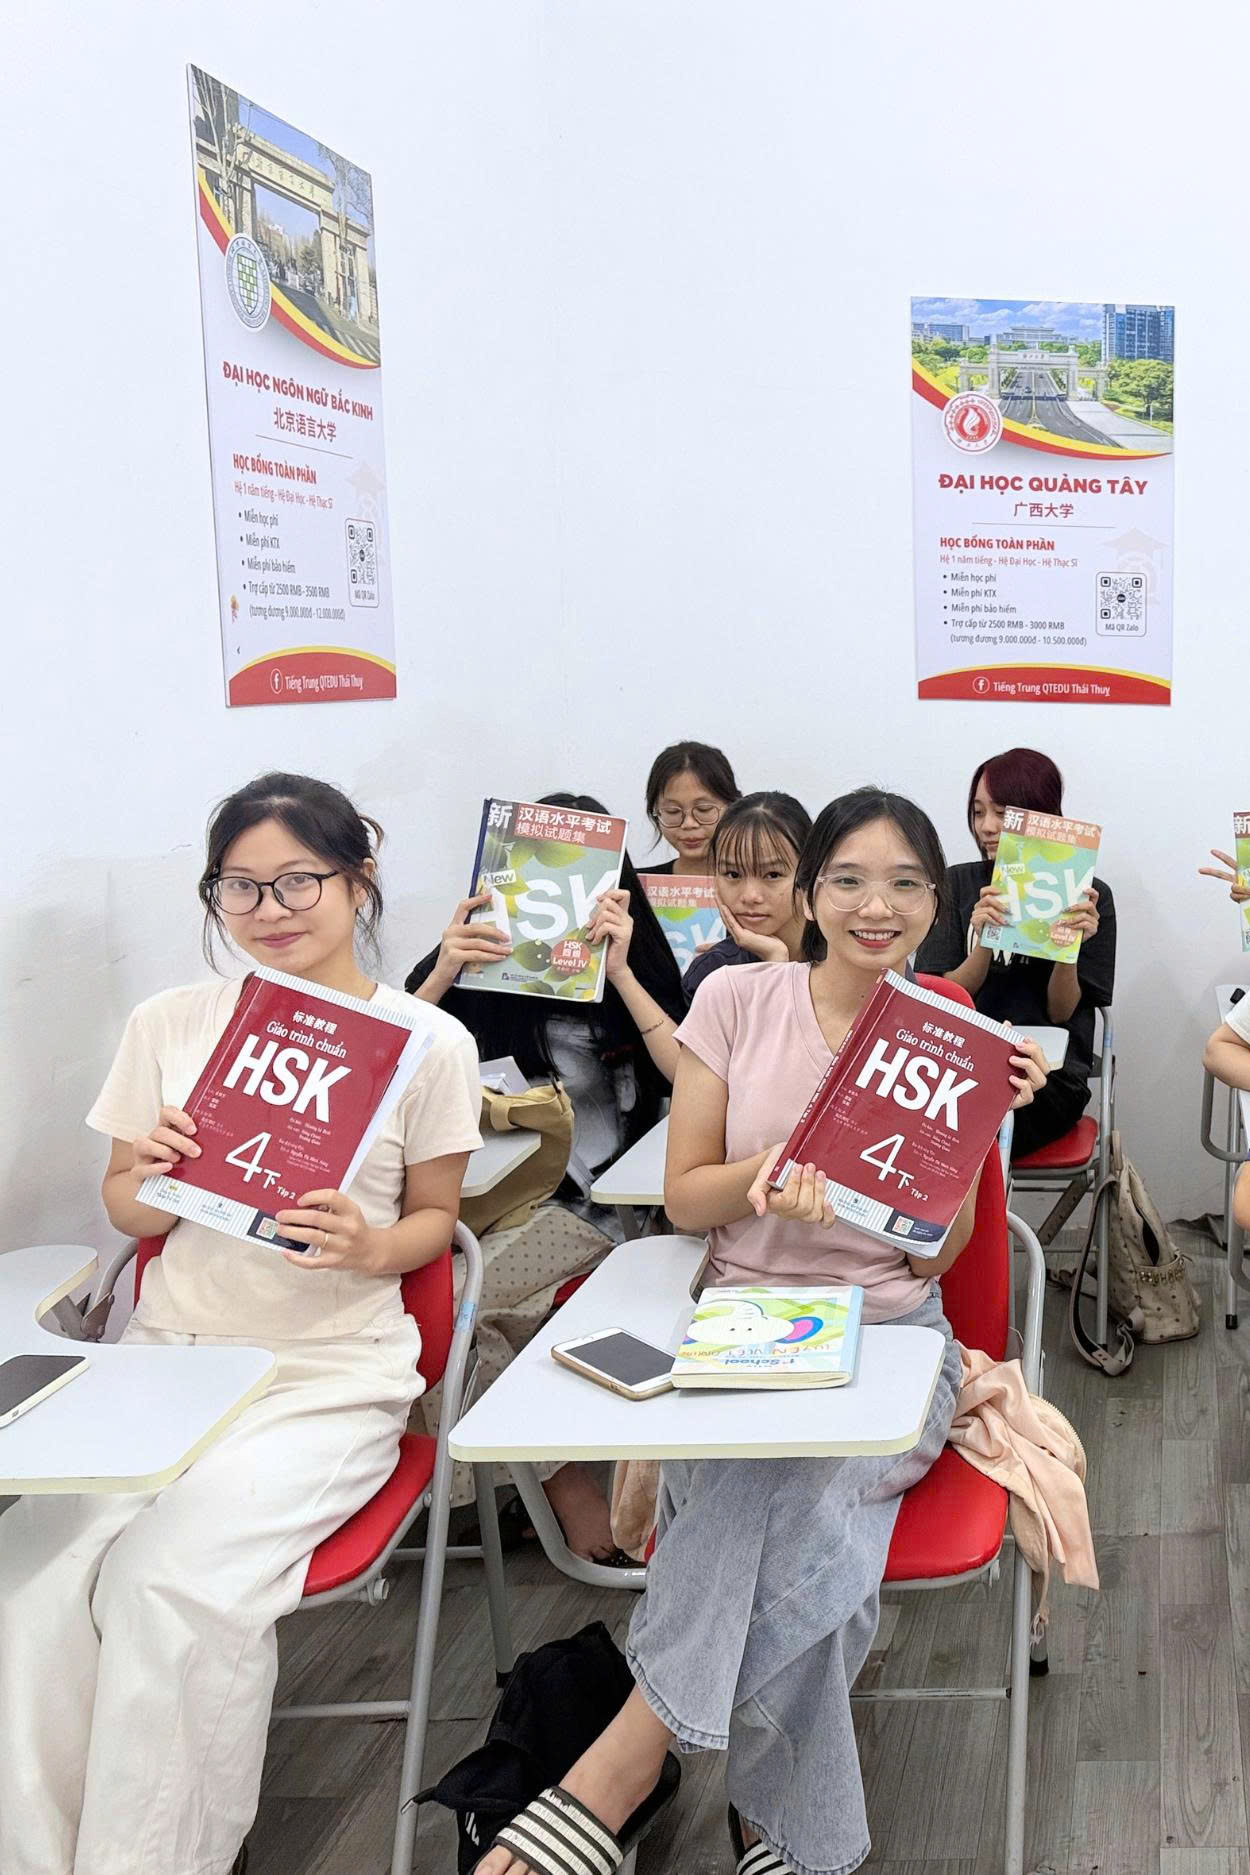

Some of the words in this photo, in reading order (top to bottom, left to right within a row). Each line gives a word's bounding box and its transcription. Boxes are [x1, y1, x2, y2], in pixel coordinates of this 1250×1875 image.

[223, 361, 244, 387] ĐẠI
[246, 368, 271, 393] HỌC
[272, 376, 304, 401] NGÔN
[306, 387, 329, 407] NGỮ
[331, 389, 351, 414] BẮC
[352, 401, 373, 421] KINH
[273, 407, 337, 443] 北京语言大学
[233, 453, 250, 474] HỌC
[274, 460, 295, 480] TOÀN
[296, 464, 317, 485] PHẦN
[938, 474, 975, 494] ĐẠI
[980, 475, 1024, 495] HỌC
[1107, 476, 1148, 495] TÂY
[1014, 502, 1074, 519] 广西大学
[940, 537, 962, 550] HỌC
[995, 537, 1024, 550] TOÀN
[1026, 537, 1055, 551] PHẦN
[970, 573, 984, 583] học
[993, 681, 1016, 695] Tiếng
[1017, 682, 1041, 696] Trung
[487, 802, 513, 828] 新
[518, 806, 612, 834] 汉语水平考试
[1004, 810, 1024, 831] 新
[515, 821, 586, 844] 模拟试题集
[293, 1011, 338, 1034] 标准教程
[923, 1021, 966, 1048] 标准教程
[267, 1020, 288, 1039] Giáo
[289, 1029, 314, 1047] trình
[316, 1041, 347, 1059] chuẩn
[896, 1028, 918, 1047] Giáo
[919, 1038, 944, 1059] trình
[945, 1050, 975, 1072] chuẩn
[223, 1033, 352, 1123] HSK
[855, 1037, 979, 1131] HSK
